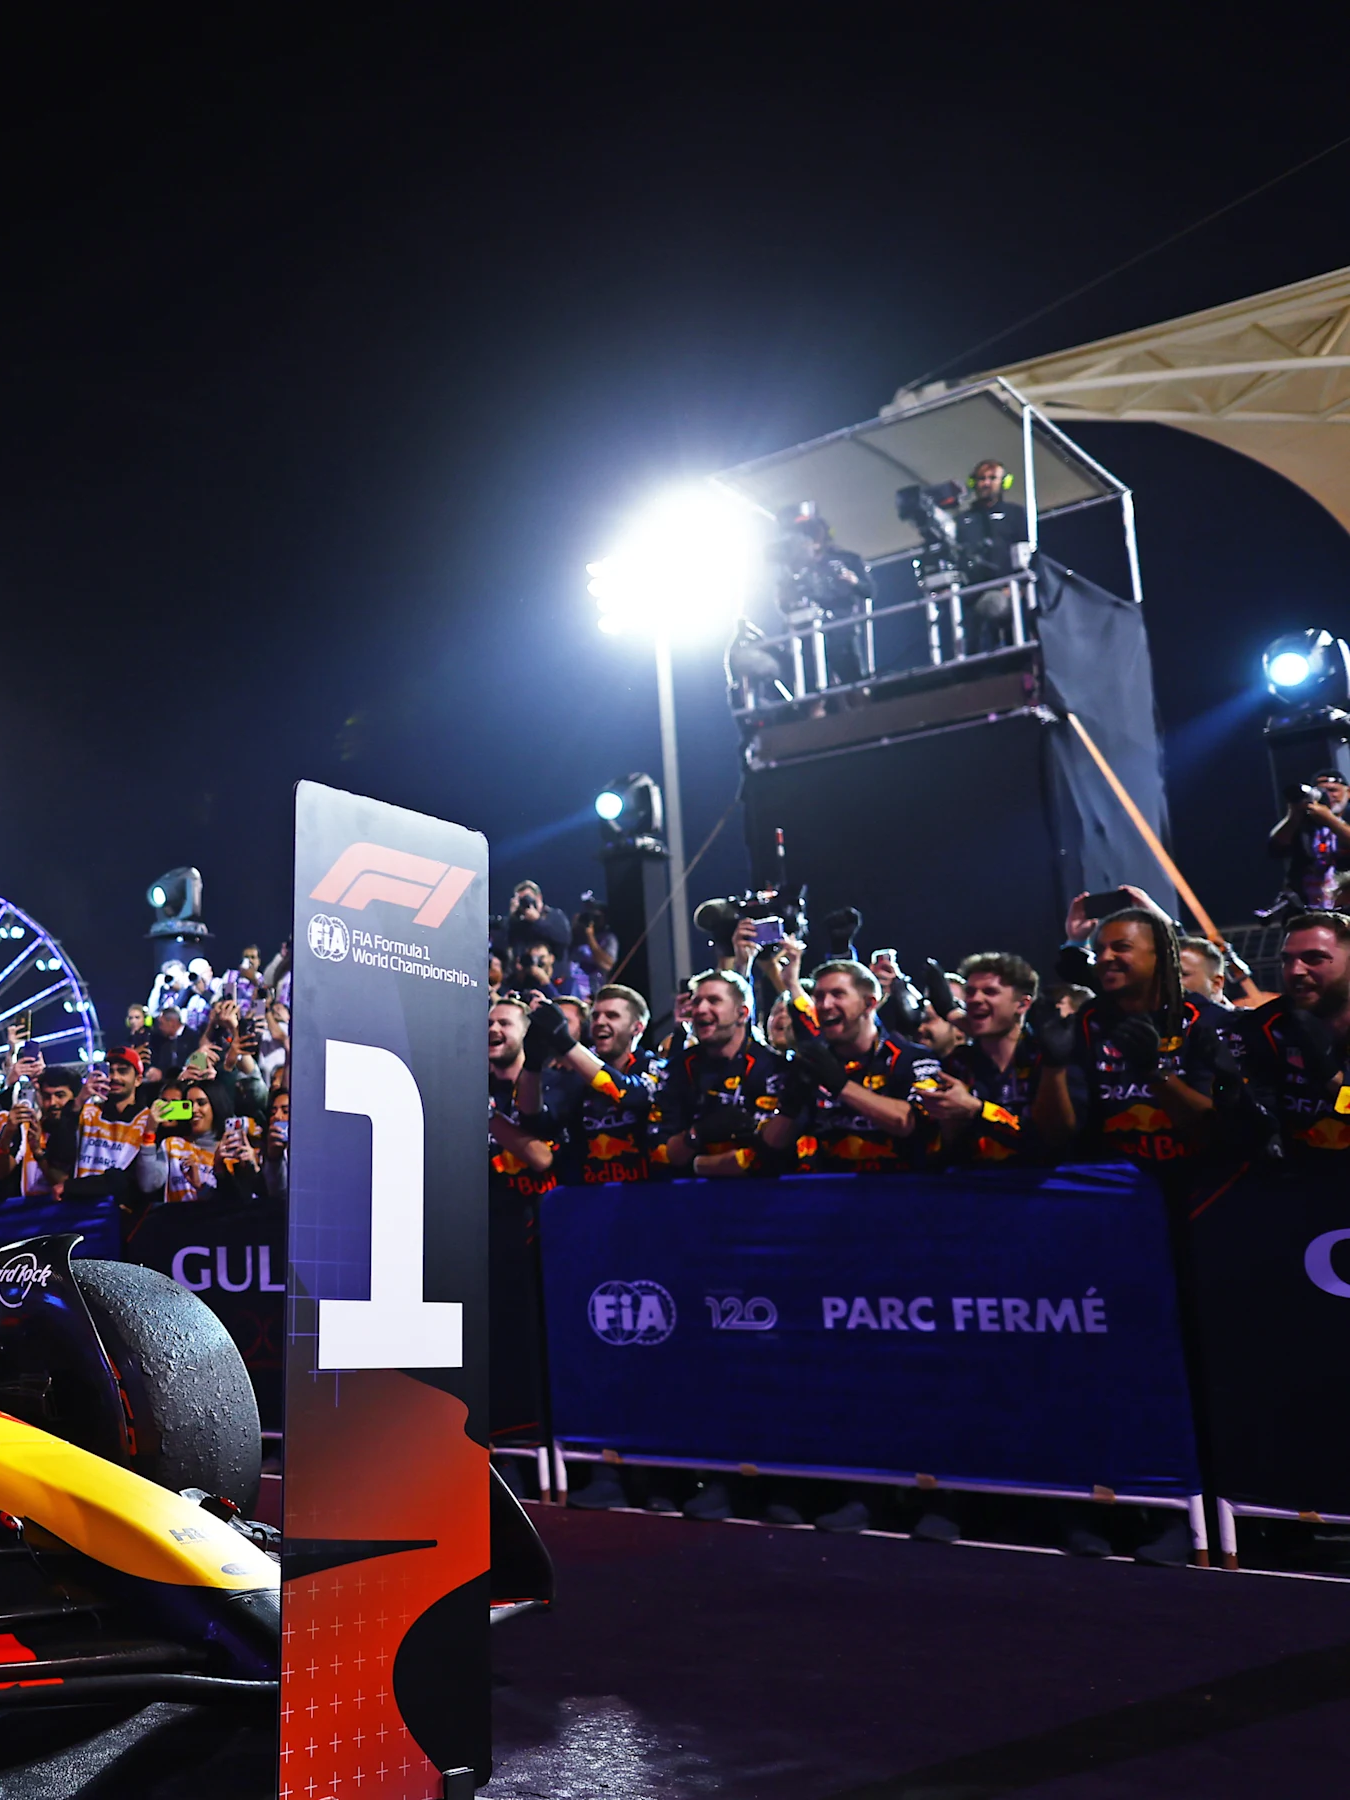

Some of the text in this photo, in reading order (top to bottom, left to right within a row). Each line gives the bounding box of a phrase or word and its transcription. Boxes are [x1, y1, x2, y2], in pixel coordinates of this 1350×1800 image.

[352, 929, 431, 960] FIA Formula 1
[352, 947, 389, 969] World
[390, 955, 470, 987] Championship
[318, 1039, 463, 1369] 1
[171, 1245, 287, 1293] GUL
[821, 1296, 936, 1332] PARC
[952, 1286, 1109, 1334] FERMÉ
